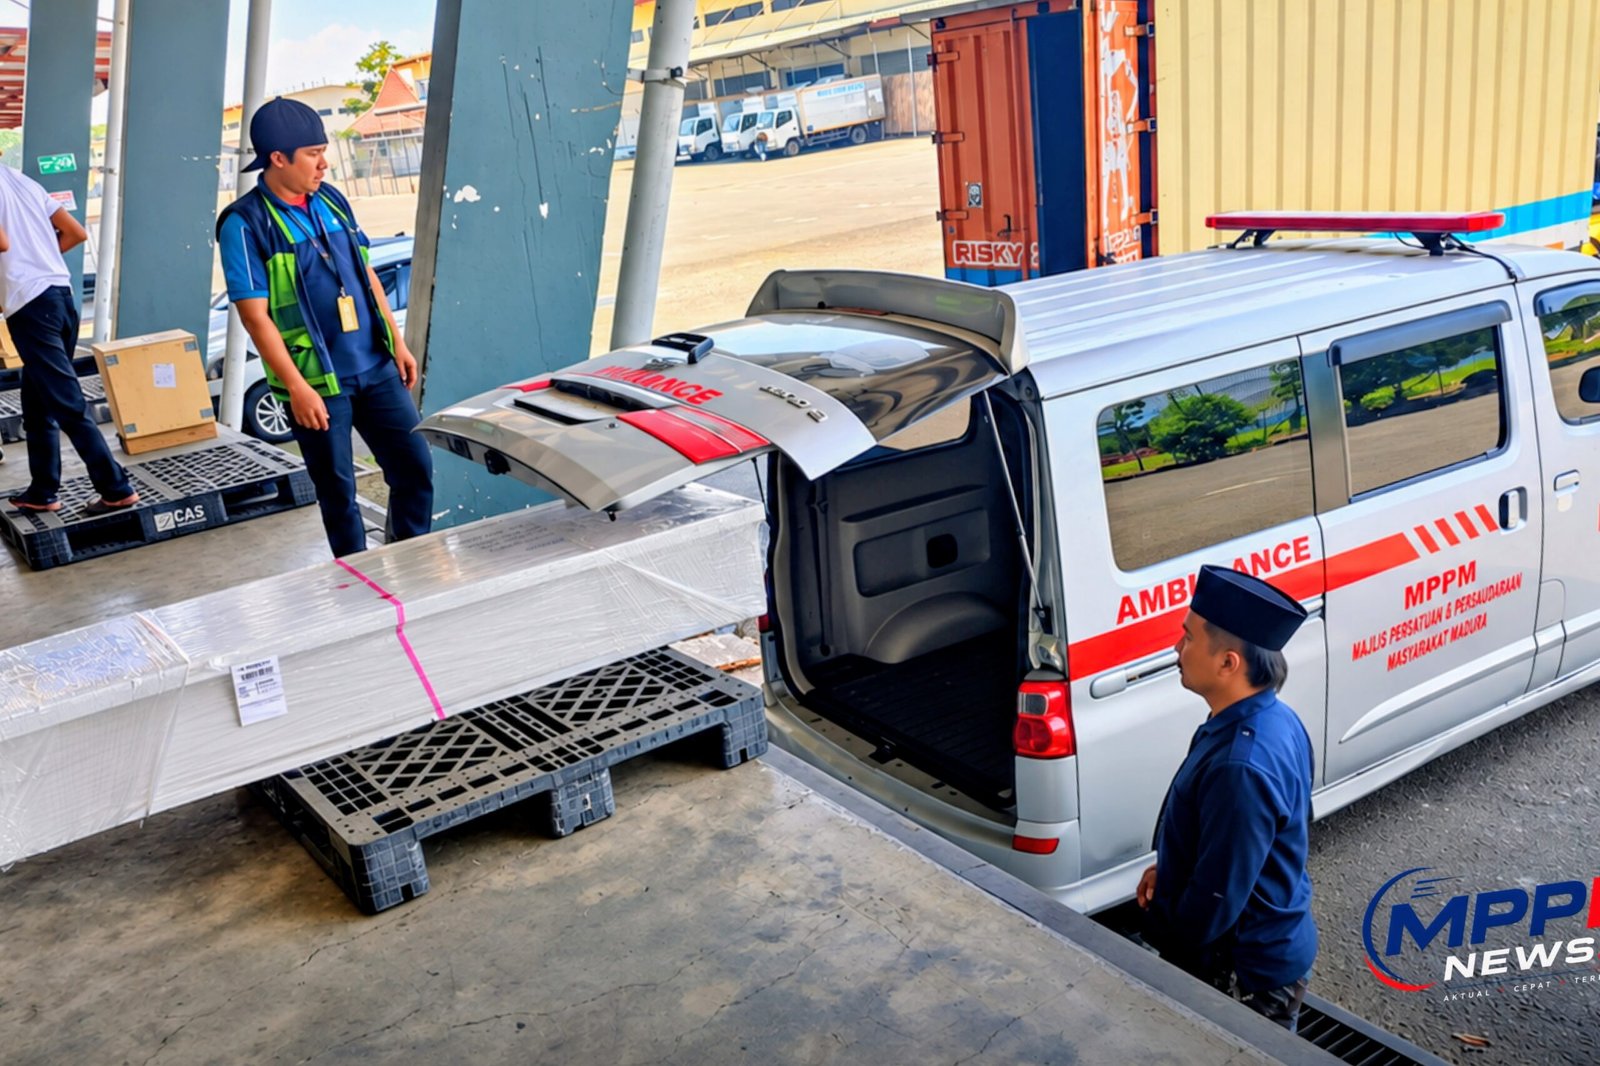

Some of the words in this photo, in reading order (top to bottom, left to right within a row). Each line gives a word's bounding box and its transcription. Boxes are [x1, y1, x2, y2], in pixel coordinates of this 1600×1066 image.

[953, 240, 1024, 267] RISKY
[174, 505, 205, 522] CAS
[1116, 536, 1311, 625] AMBANCE
[1404, 560, 1477, 610] MPPM
[1352, 630, 1388, 661] MAJLIS
[1389, 606, 1443, 645] PERSATUAN
[1454, 572, 1523, 616] PERSAUDARAAN
[1387, 629, 1449, 672] MASYARAKAT
[1450, 612, 1488, 643] MADURA
